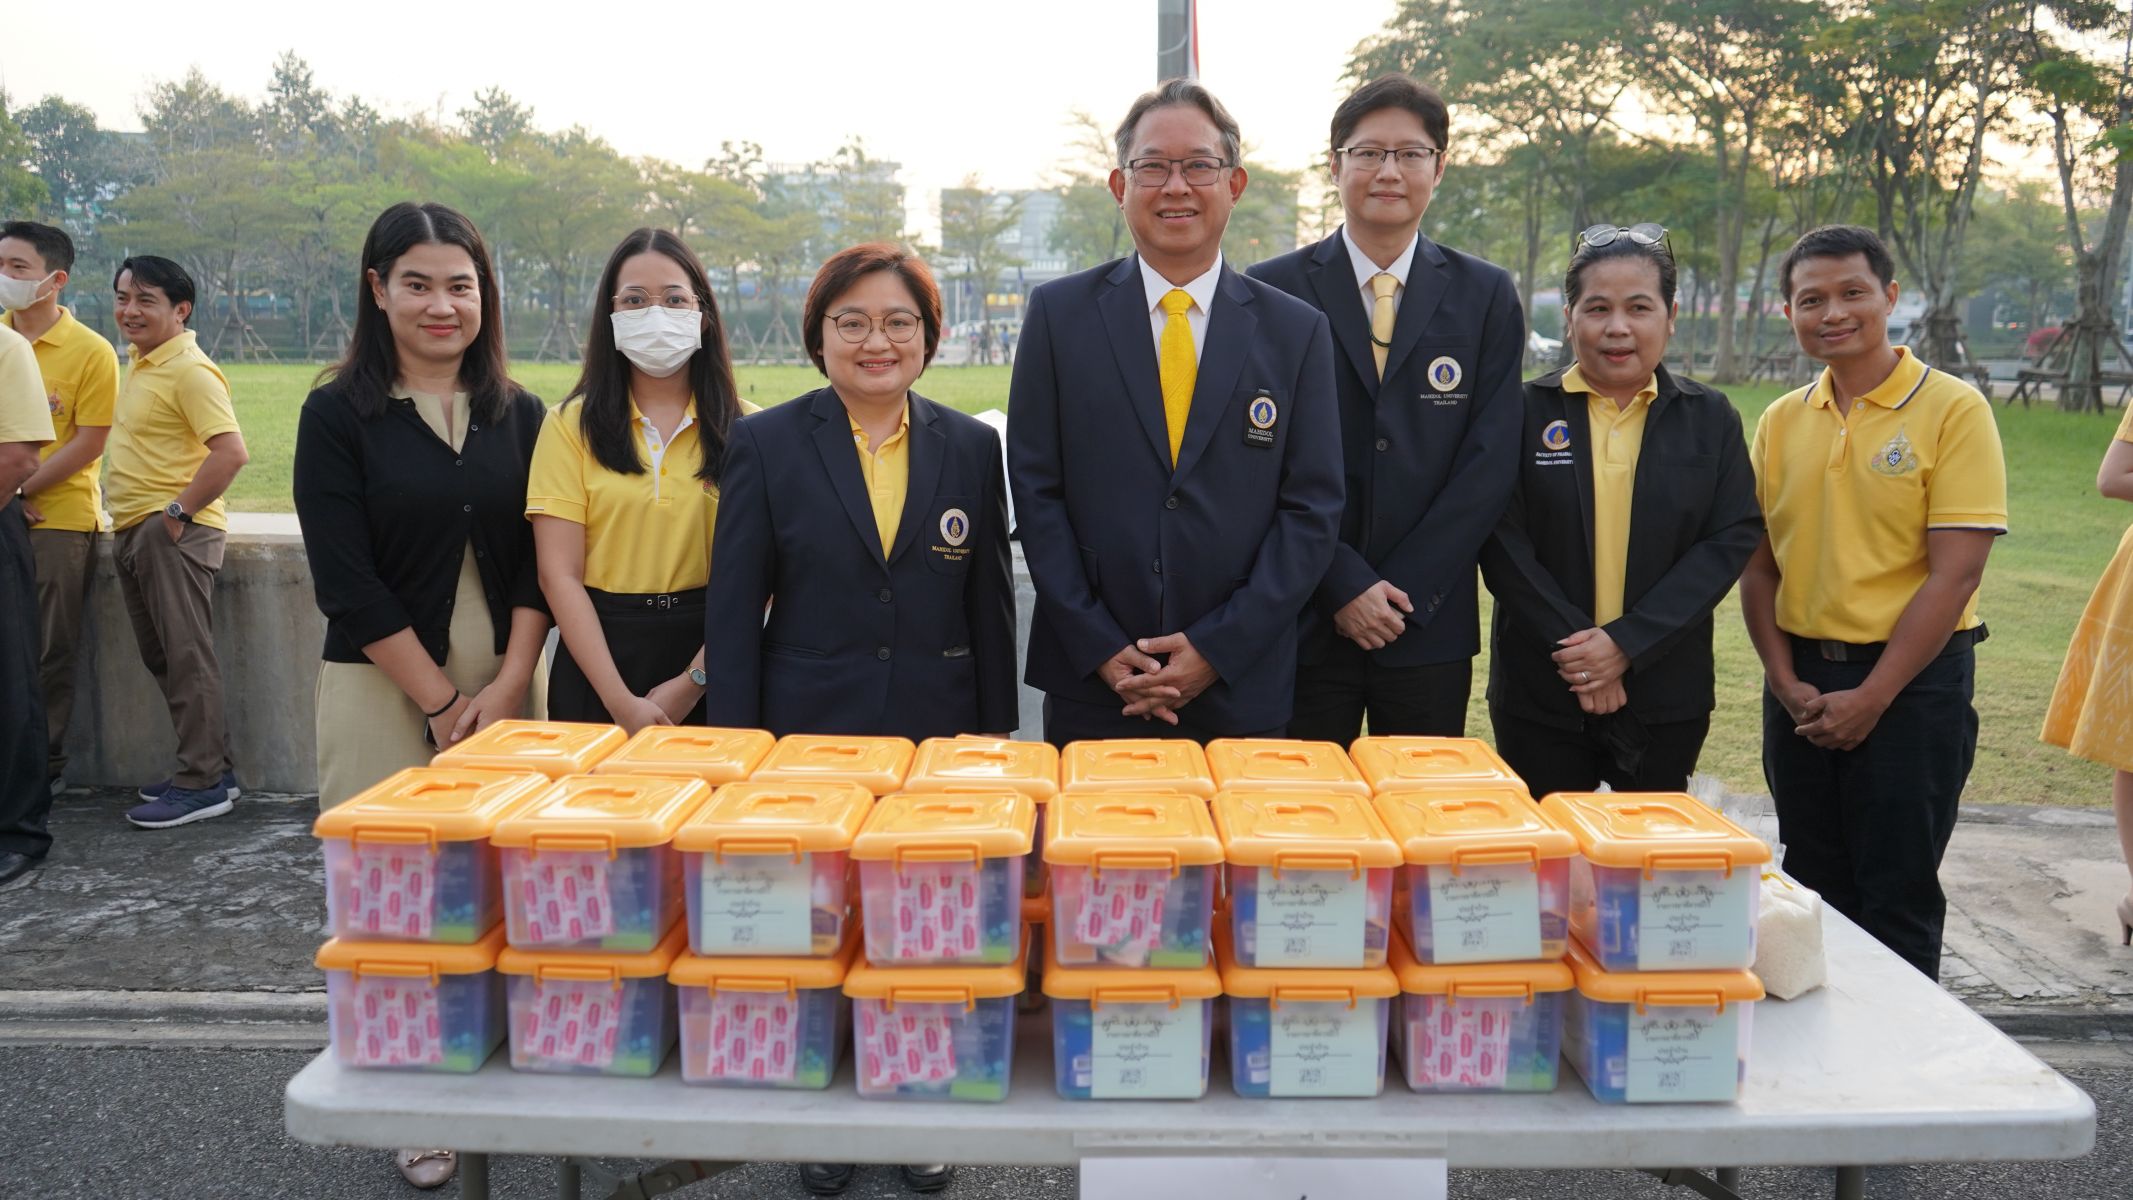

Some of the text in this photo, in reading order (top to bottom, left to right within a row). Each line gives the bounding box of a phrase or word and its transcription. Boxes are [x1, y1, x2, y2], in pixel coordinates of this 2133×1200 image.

[1248, 427, 1274, 437] MAHIDOL
[1247, 433, 1273, 443] UNIVERSITY
[931, 545, 952, 553] MAHIDOL
